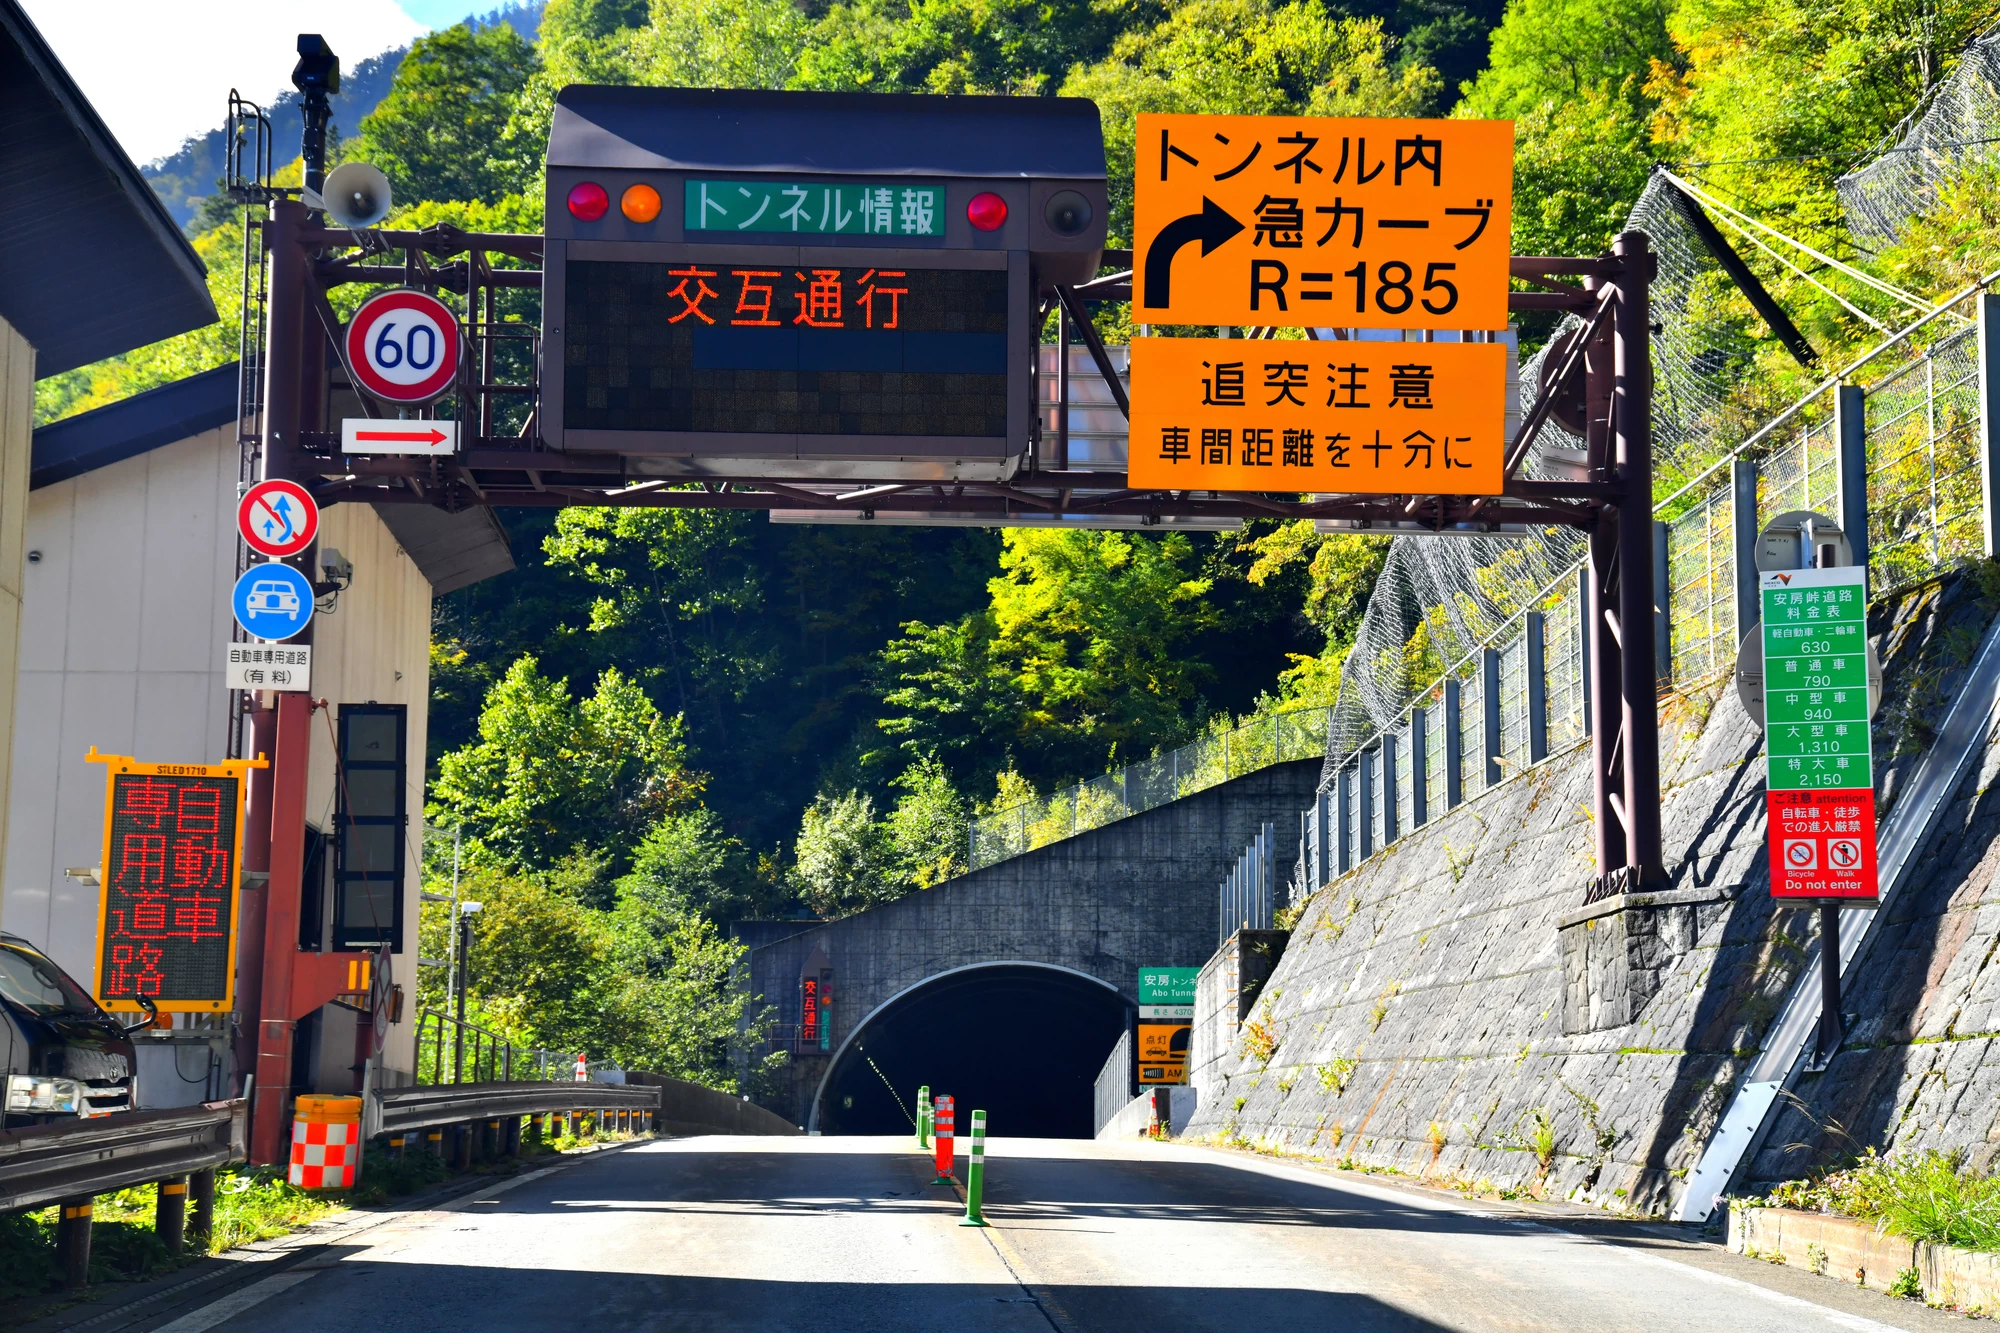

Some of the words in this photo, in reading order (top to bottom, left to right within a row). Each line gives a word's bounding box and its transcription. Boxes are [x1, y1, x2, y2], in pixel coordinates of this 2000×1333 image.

[1160, 129, 1441, 187] トンネル内
[699, 183, 935, 235] トンネル情報
[1252, 194, 1493, 251] 急カーブ
[1250, 259, 1459, 315] R=185
[666, 265, 909, 329] 交互通行
[375, 322, 436, 370] 60
[1201, 360, 1435, 410] 追突注意
[1159, 426, 1473, 469] 車間距離を十分に
[1774, 590, 1853, 606] 安房峠道路
[1787, 605, 1841, 620] 料金表
[1801, 640, 1831, 654] 630
[230, 649, 307, 665] 自動車専用道路
[1785, 658, 1846, 673] 普通車
[1803, 675, 1831, 688] 790
[1785, 691, 1847, 706] 中型車
[1804, 708, 1832, 720] 940
[1787, 724, 1848, 738] 大型車
[1799, 740, 1840, 754] 1,310
[1788, 757, 1850, 771] 特大車
[1799, 773, 1842, 787] 2,150
[1774, 792, 1813, 804] ご注意
[1816, 794, 1867, 804] attention
[1782, 806, 1861, 819] 自転車・徒歩
[1782, 820, 1861, 833] での進入厳禁
[170, 781, 229, 943] 自動車
[1787, 870, 1815, 878] Bicycle
[106, 776, 177, 996] 専用道路
[1785, 880, 1803, 890] Do
[1806, 880, 1826, 890] not
[1830, 880, 1863, 890] enter
[1152, 989, 1169, 997] Abo
[803, 980, 817, 1041] 交互通行
[1146, 1035, 1167, 1045] 点灯
